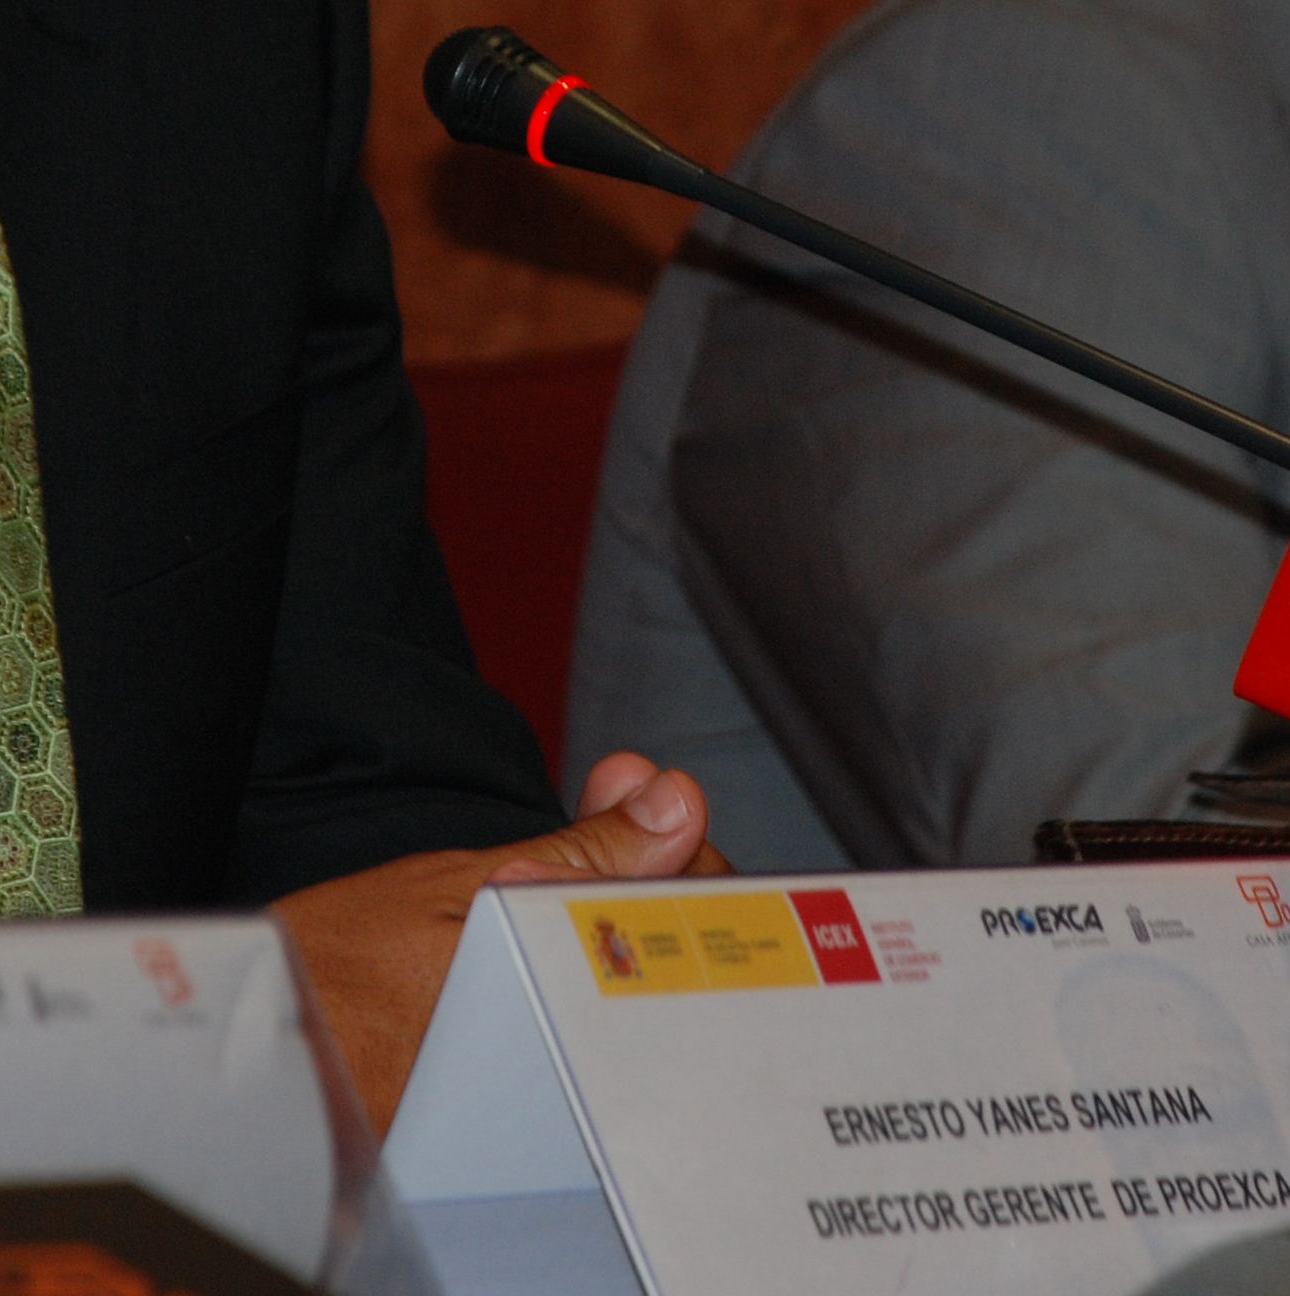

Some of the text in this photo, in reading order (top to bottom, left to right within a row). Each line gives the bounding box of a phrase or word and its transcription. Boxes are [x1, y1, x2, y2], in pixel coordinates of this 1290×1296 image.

[812, 923, 859, 950] ICEX
[980, 903, 1105, 938] PROEXCA
[823, 1085, 1213, 1147] ERNESTO YANES SANTANA
[808, 1189, 965, 1240] DIRECTOR
[963, 1180, 1106, 1229] GERENTE
[1111, 1177, 1159, 1218] DE
